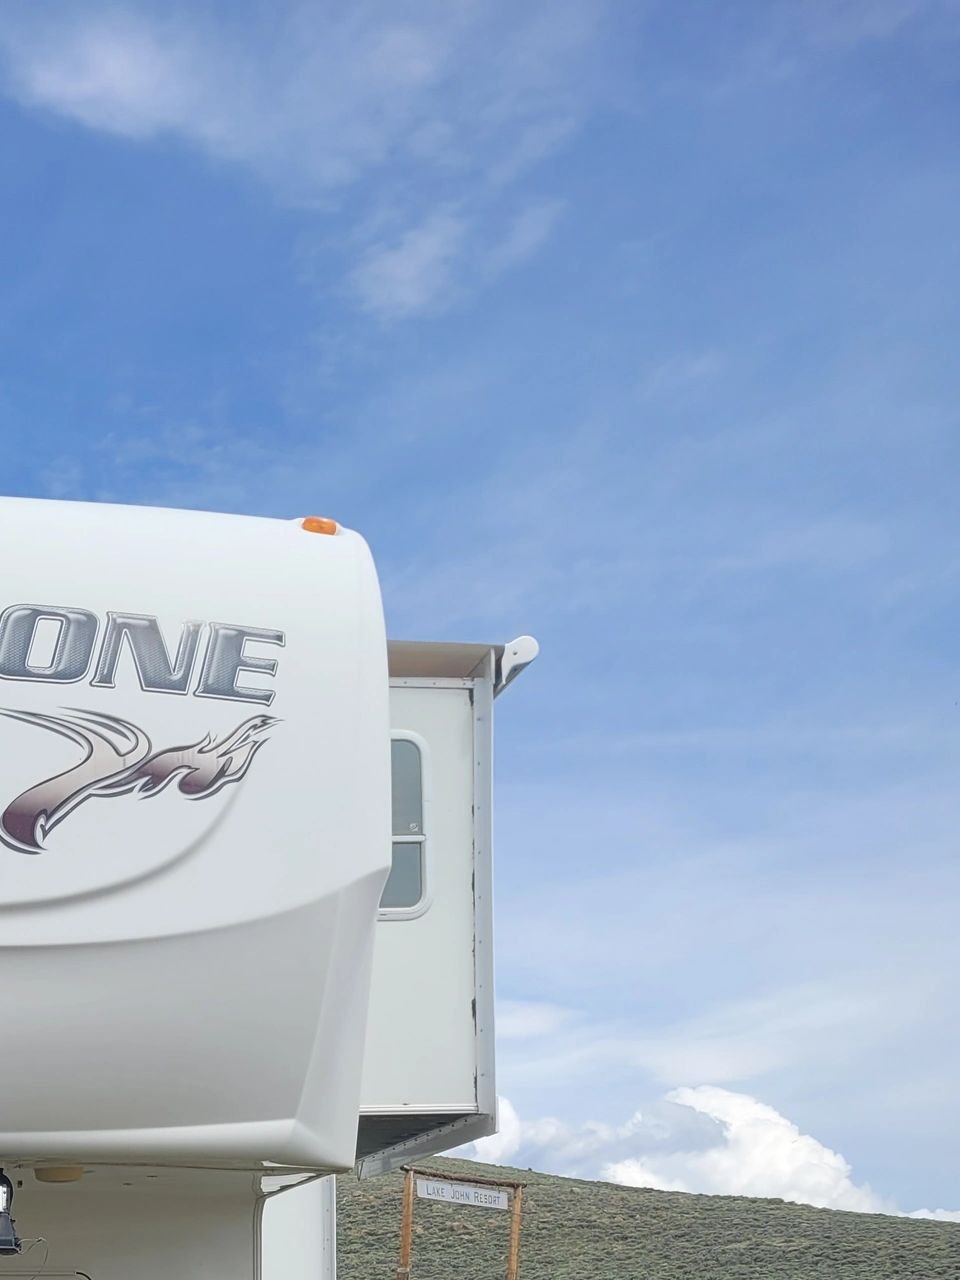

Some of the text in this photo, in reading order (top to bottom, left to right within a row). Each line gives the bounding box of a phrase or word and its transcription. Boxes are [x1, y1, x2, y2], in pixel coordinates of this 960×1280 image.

[426, 1184, 500, 1205] LAKE JOHN RESORT
